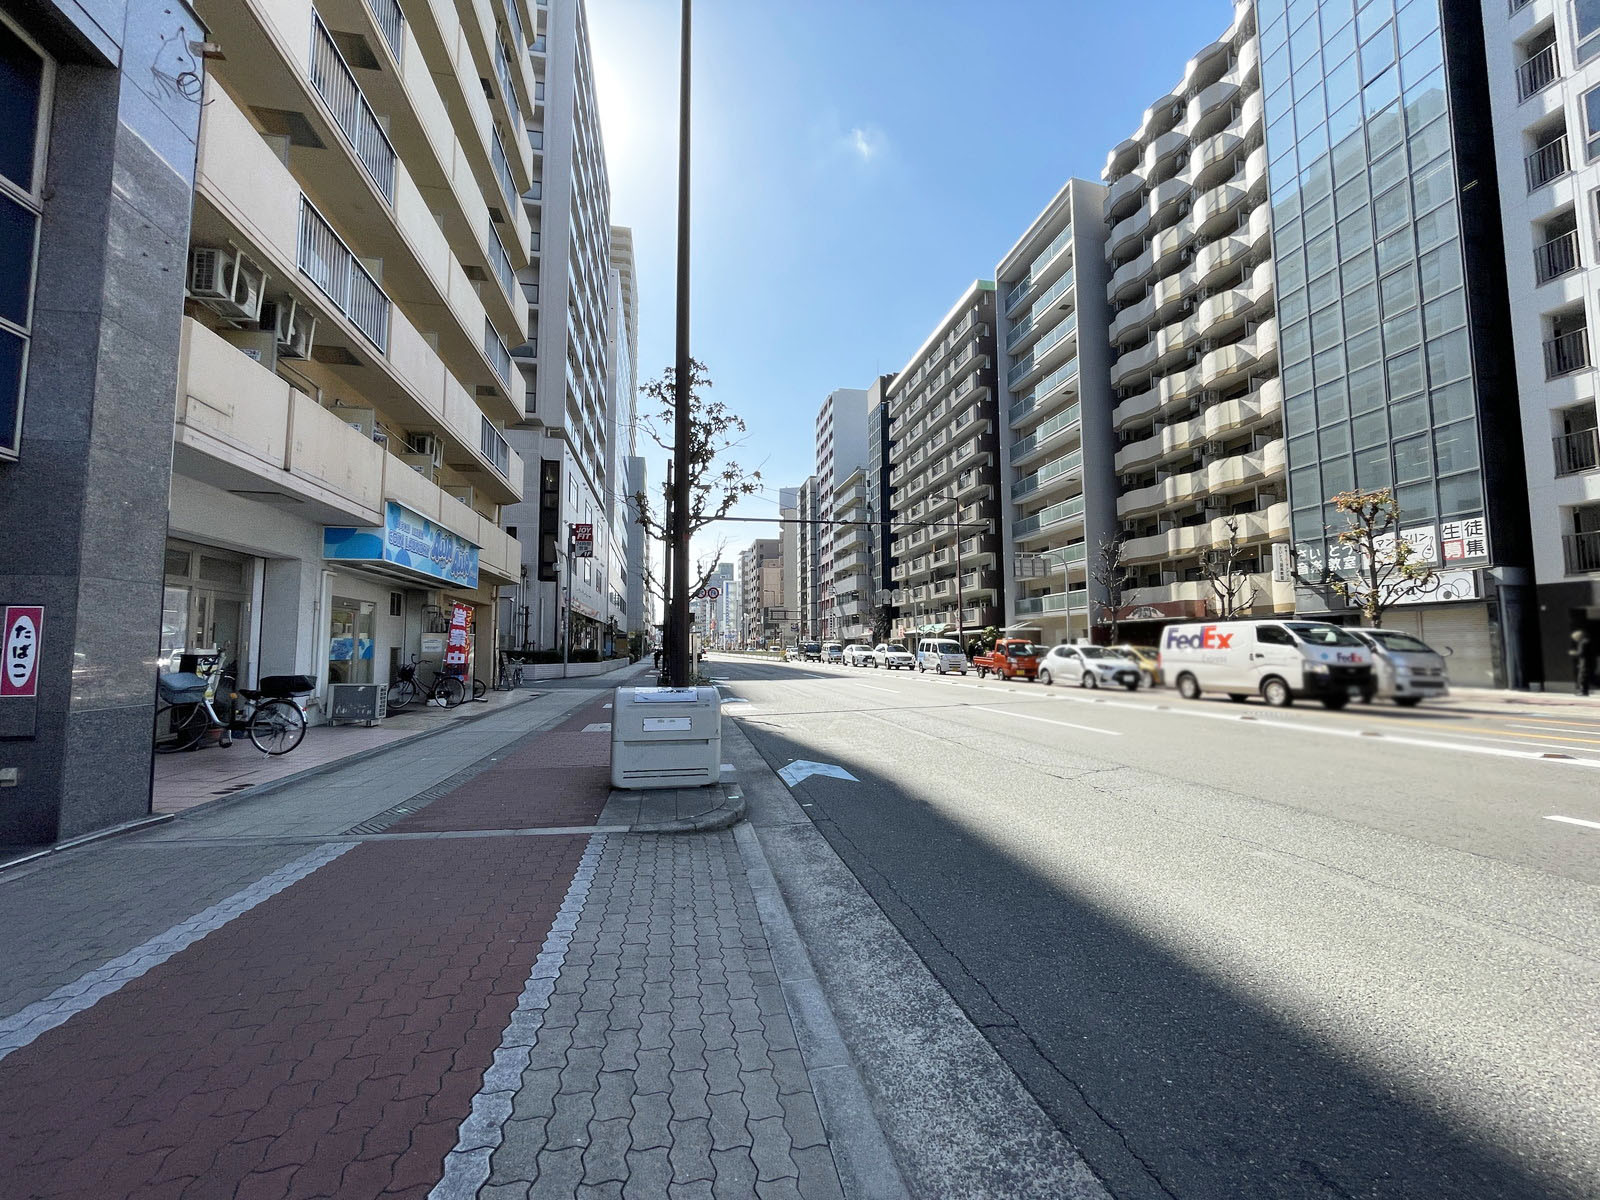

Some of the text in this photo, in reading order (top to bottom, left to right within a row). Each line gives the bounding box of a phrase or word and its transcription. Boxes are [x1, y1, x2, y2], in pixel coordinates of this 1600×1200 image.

[1442, 519, 1484, 541] 生徒
[1296, 555, 1357, 575] 音楽教室
[447, 607, 467, 664] 営業中
[1166, 625, 1234, 649] FedEx
[12, 624, 32, 678] たばこ
[1336, 652, 1362, 663] FedEx
